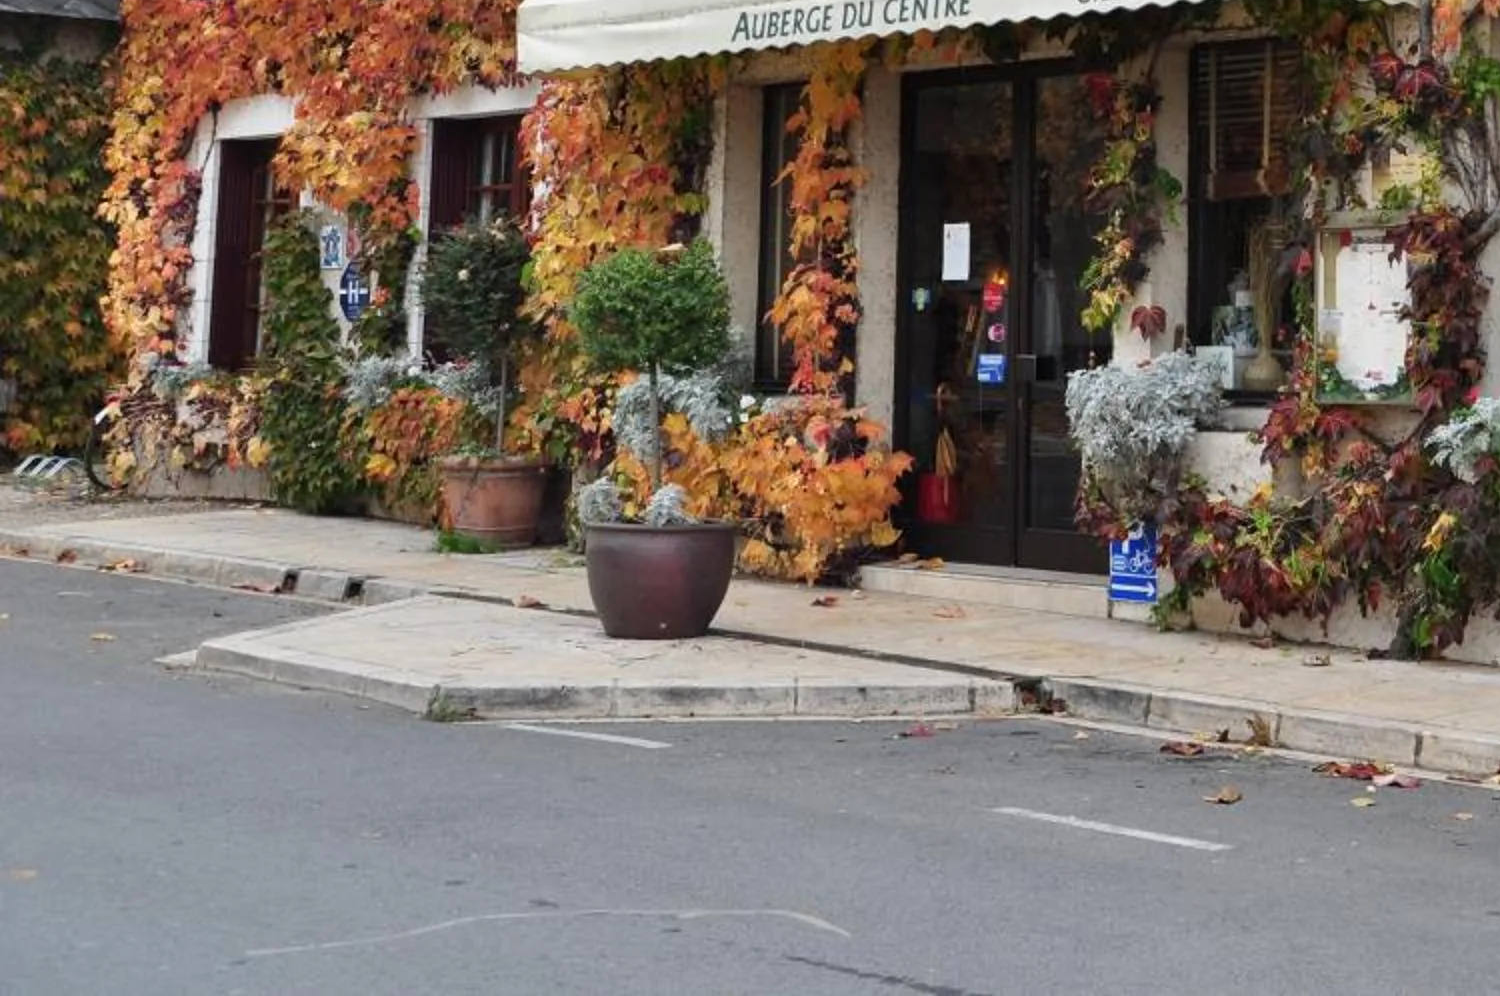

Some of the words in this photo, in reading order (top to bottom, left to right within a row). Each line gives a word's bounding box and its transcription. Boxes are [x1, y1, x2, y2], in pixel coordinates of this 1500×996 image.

[731, 5, 833, 42] AUBERGE
[842, 0, 874, 29] DU
[347, 280, 359, 304] H
